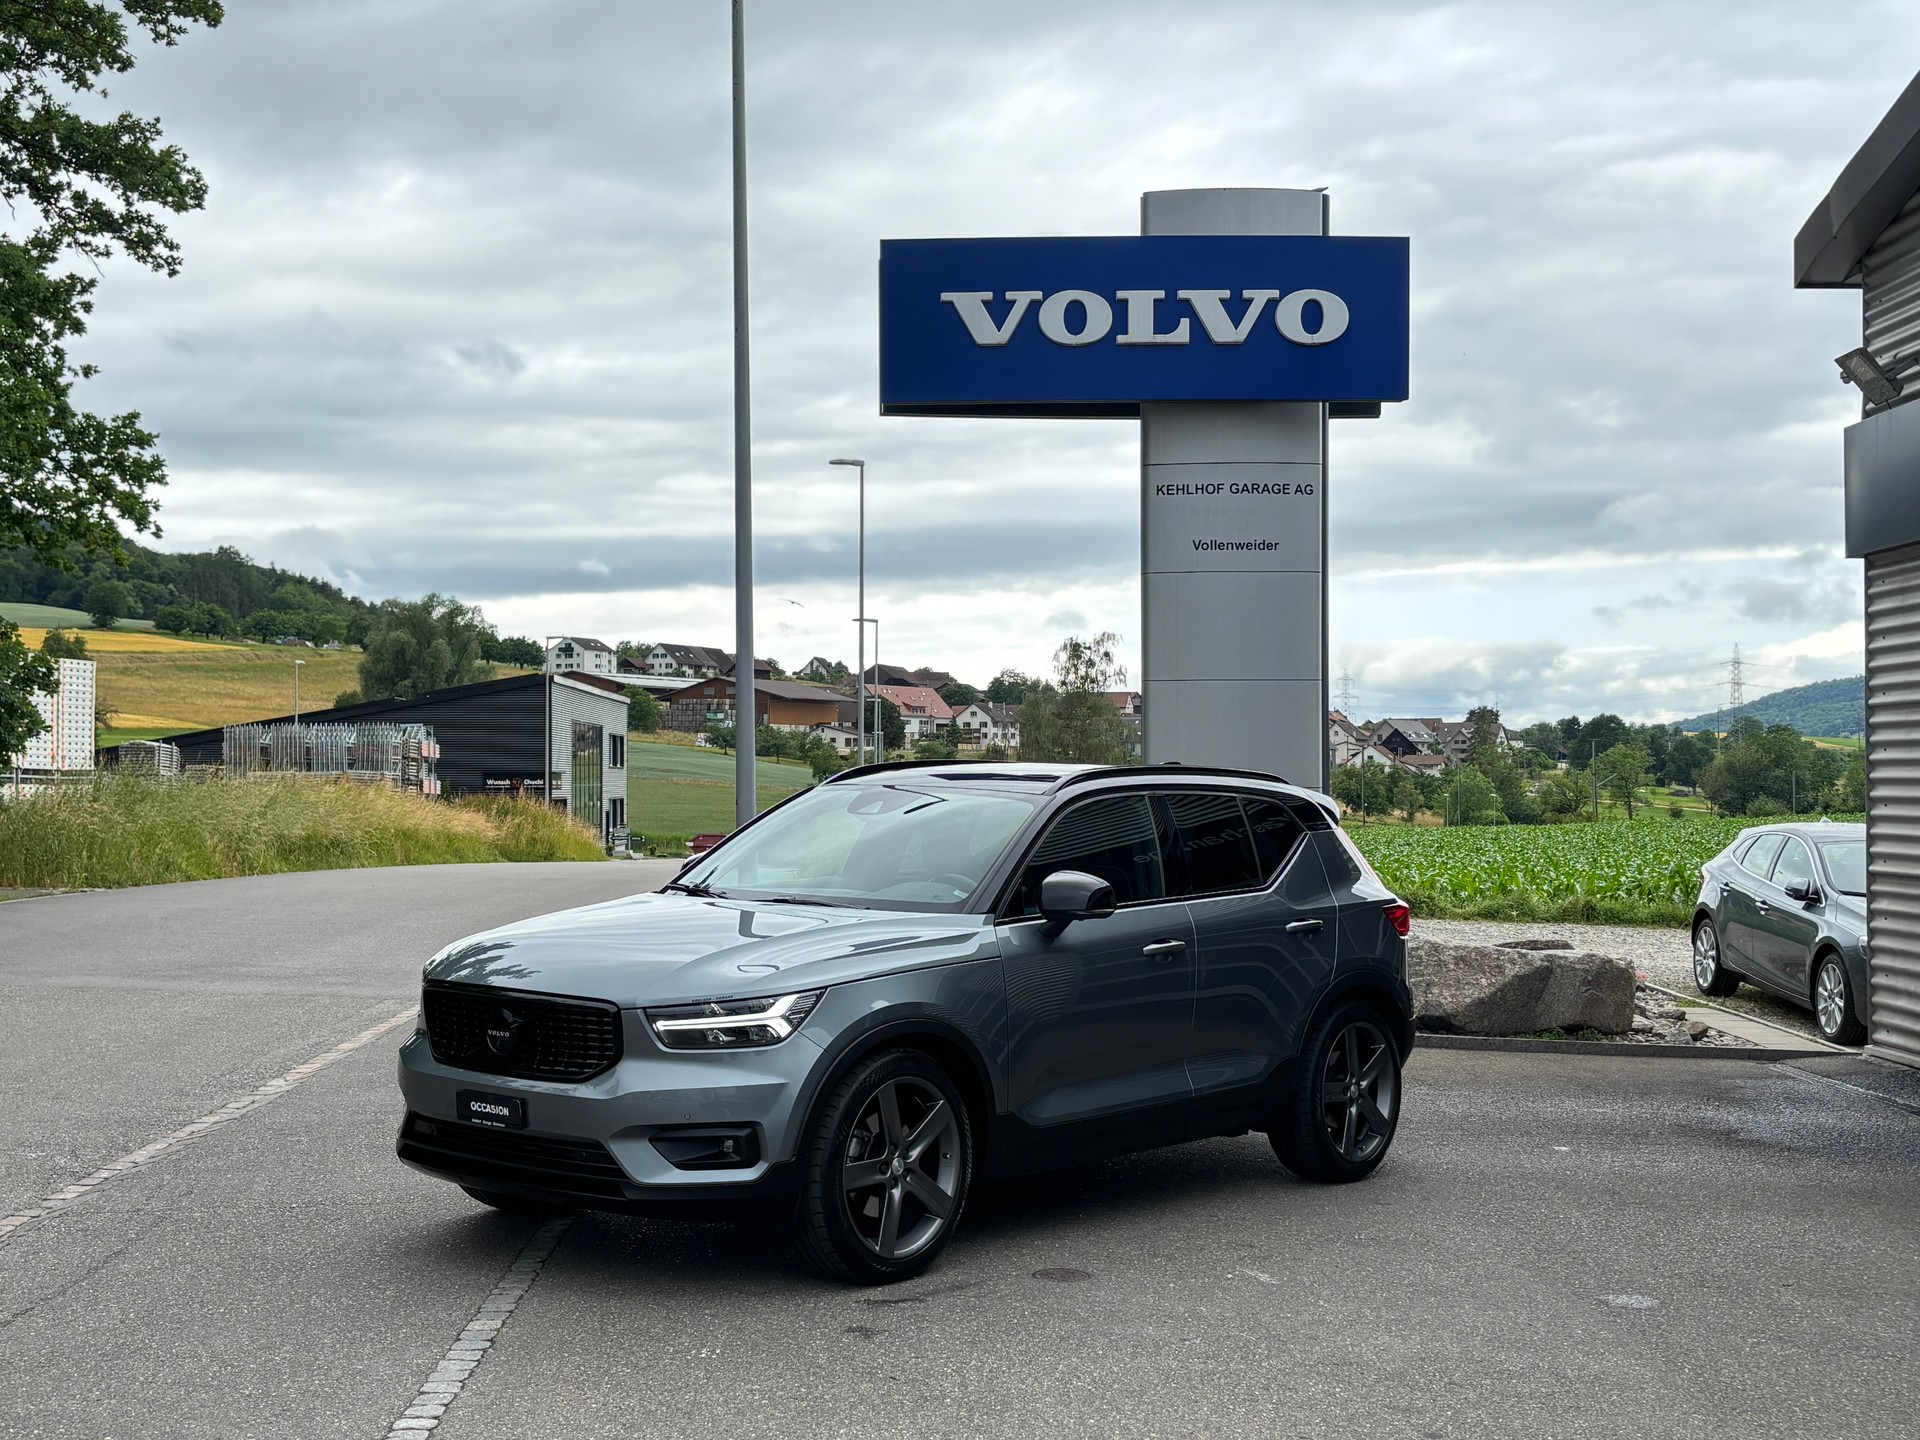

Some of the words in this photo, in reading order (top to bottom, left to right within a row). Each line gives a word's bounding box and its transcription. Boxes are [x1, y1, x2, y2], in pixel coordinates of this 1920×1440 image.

[940, 289, 1350, 347] VOLVO
[1156, 483, 1225, 496] KEHLHOF
[1229, 483, 1291, 495] GARAGE
[1294, 484, 1314, 495] AG
[1192, 539, 1280, 551] Vollenweider
[487, 1029, 510, 1038] VOLVO
[470, 1101, 510, 1117] OCCASION
